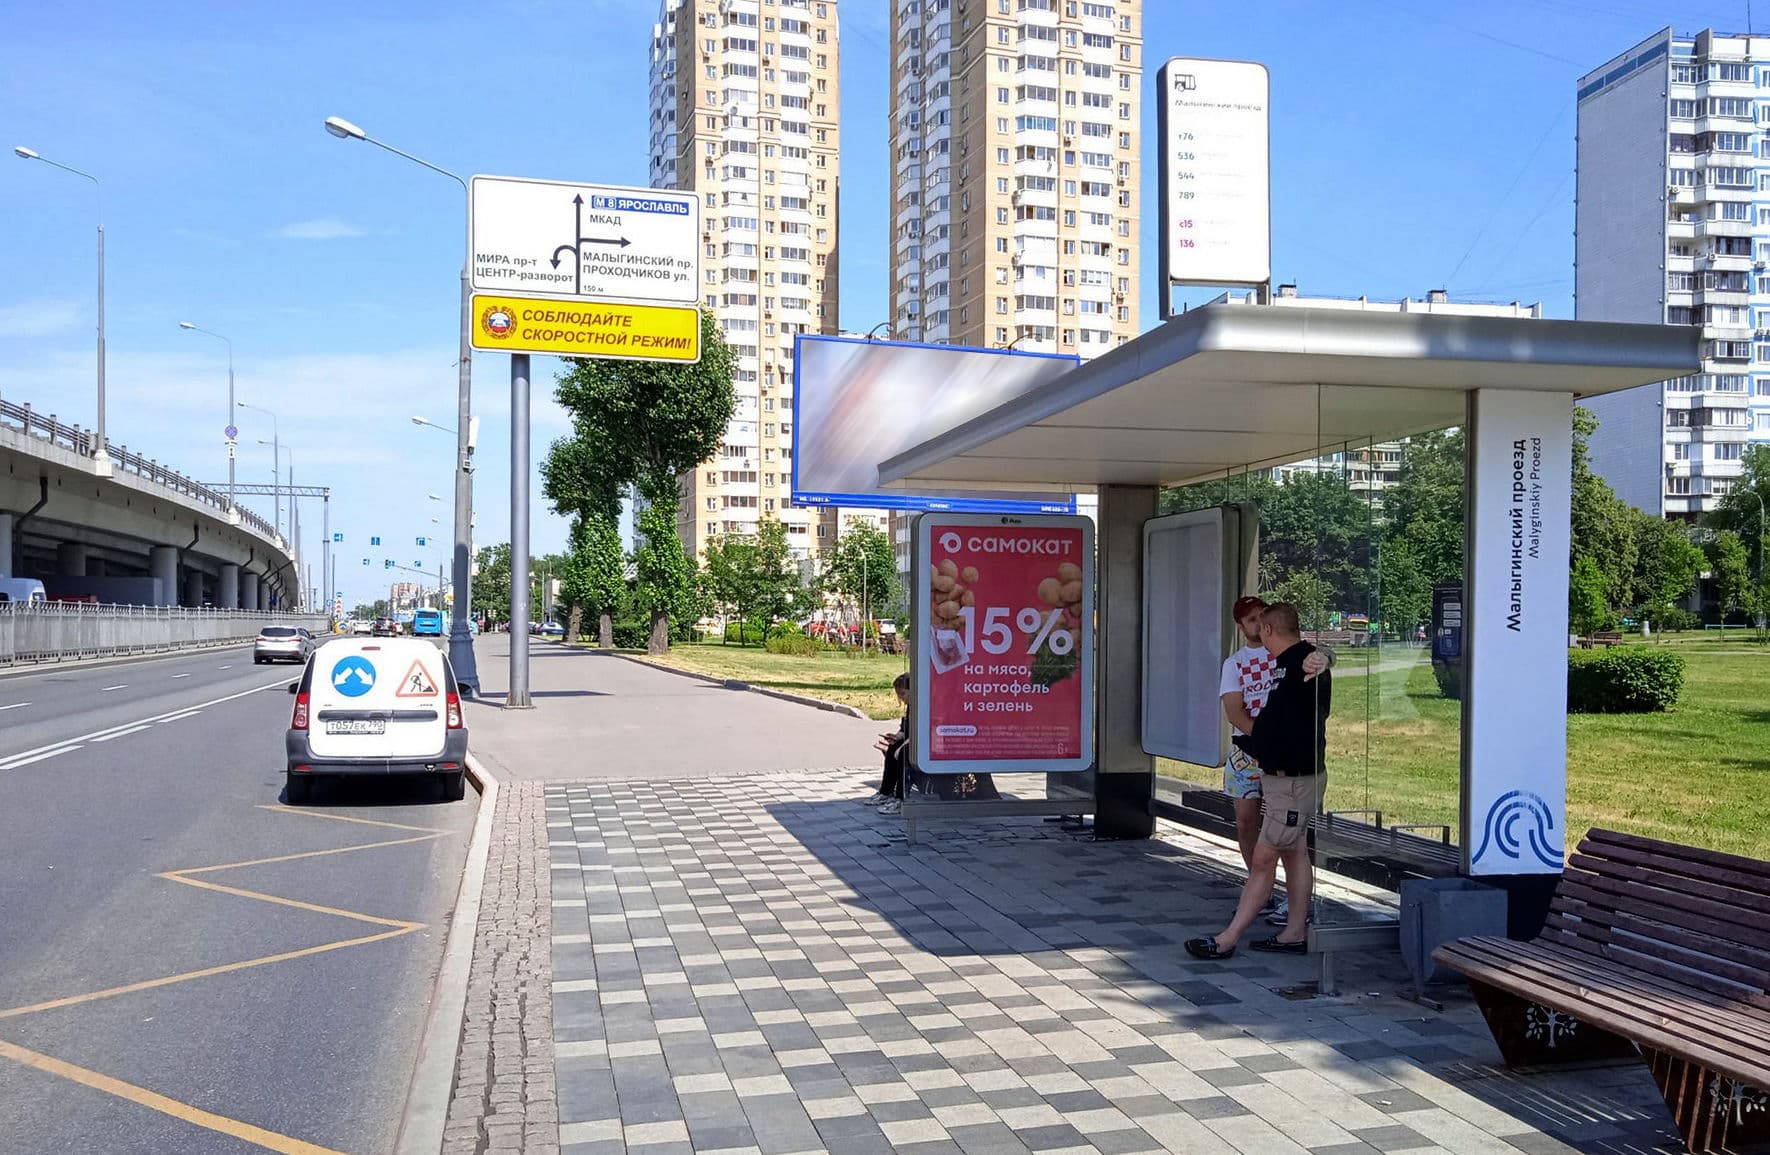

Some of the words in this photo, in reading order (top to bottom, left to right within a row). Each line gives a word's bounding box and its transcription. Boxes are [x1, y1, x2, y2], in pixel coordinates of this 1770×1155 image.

[1177, 151, 1195, 160] 536
[1177, 171, 1195, 180] 544
[1178, 191, 1195, 200] 789
[618, 199, 688, 215] ЯРОСЛАВЛЬ
[590, 214, 622, 226] МКАД
[1179, 239, 1195, 248] 136
[476, 254, 511, 265] МИРА
[513, 257, 538, 267] пр-т
[583, 252, 674, 268] МАЛЫГИНСКИЙ
[677, 260, 694, 270] пр.
[476, 267, 574, 284] ЦЕНТР-разворот
[583, 265, 671, 280] ПРОХОДЧИКОВ
[673, 272, 690, 283] ул.
[583, 285, 597, 293] 150
[522, 309, 633, 328] СОБЛЮДАЙТЕ
[522, 328, 627, 346] СКОРОСТНОЙ
[631, 334, 692, 350] РЕЖИМ!
[1530, 437, 1541, 481] Proezd
[1512, 439, 1527, 503] проезд
[1528, 484, 1543, 559] Malyginskiy
[967, 536, 1073, 555] самокат
[1506, 509, 1523, 632] Малыгинский
[957, 606, 1074, 656] 15%
[964, 665, 983, 675] на
[988, 664, 1032, 677] мясо,
[963, 679, 1050, 697] картофель
[963, 701, 973, 712] и
[977, 701, 1034, 712] зелень
